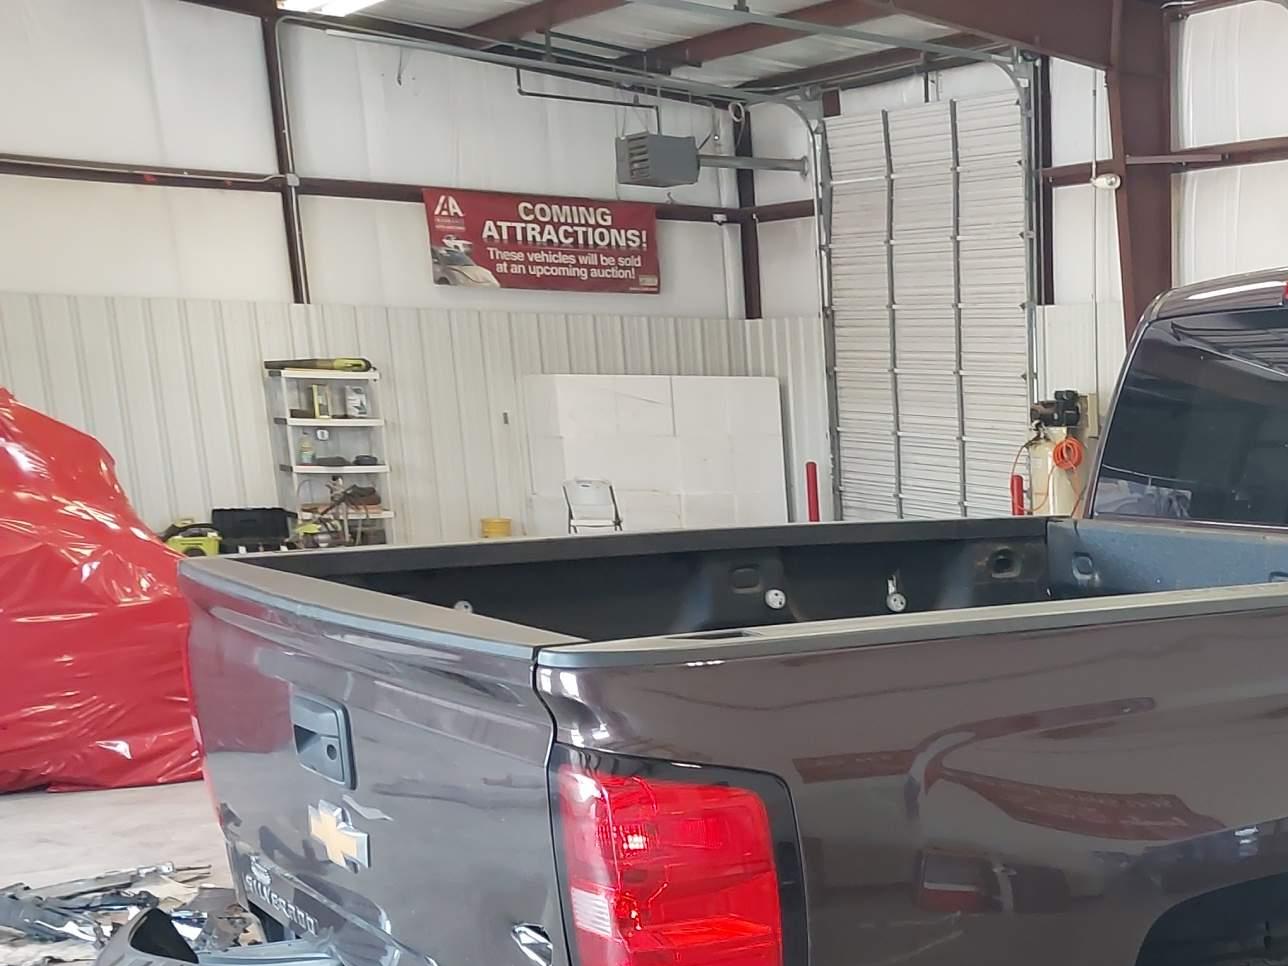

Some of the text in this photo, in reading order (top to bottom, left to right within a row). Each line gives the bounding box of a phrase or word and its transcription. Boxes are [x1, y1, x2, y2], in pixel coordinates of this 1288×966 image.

[518, 202, 612, 226] COMING
[482, 220, 647, 248] ATTRACTIONS!
[487, 247, 642, 267] These vehicles will be sold
[496, 261, 636, 280] at an upcoming auction!
[245, 874, 319, 937] SILVERADO
